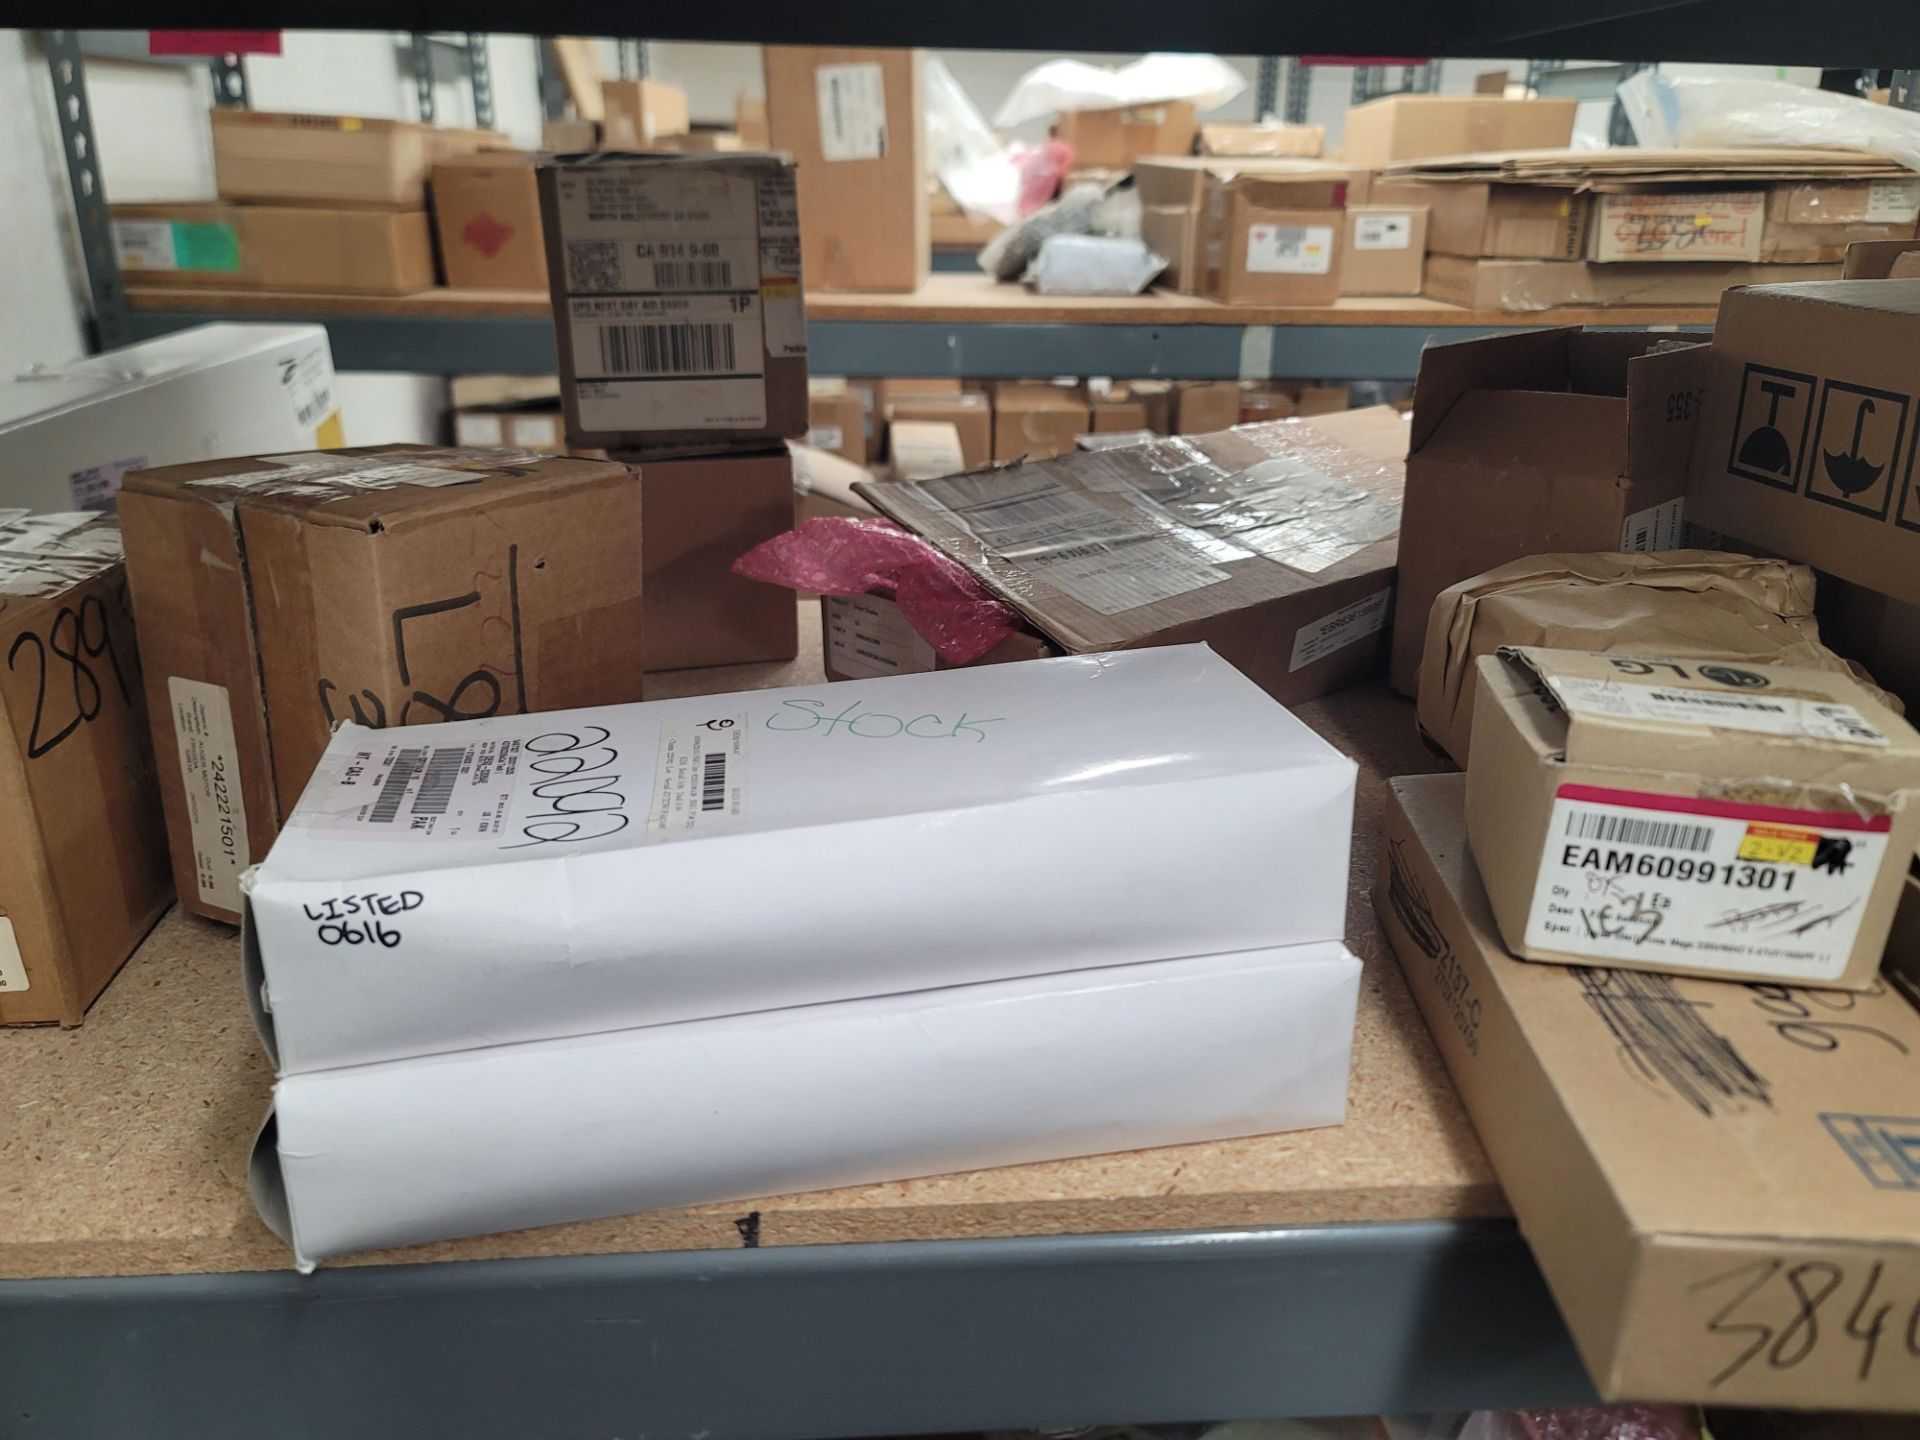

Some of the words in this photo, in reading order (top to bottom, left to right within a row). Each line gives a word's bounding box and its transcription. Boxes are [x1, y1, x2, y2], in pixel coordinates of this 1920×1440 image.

[637, 243, 654, 258] CA
[730, 296, 751, 314] 1P
[1610, 659, 1692, 681] LG
[410, 816, 429, 830] PAK
[1561, 844, 1798, 892] EAM60991301
[302, 890, 424, 921] LISTED
[317, 920, 402, 948] 0616
